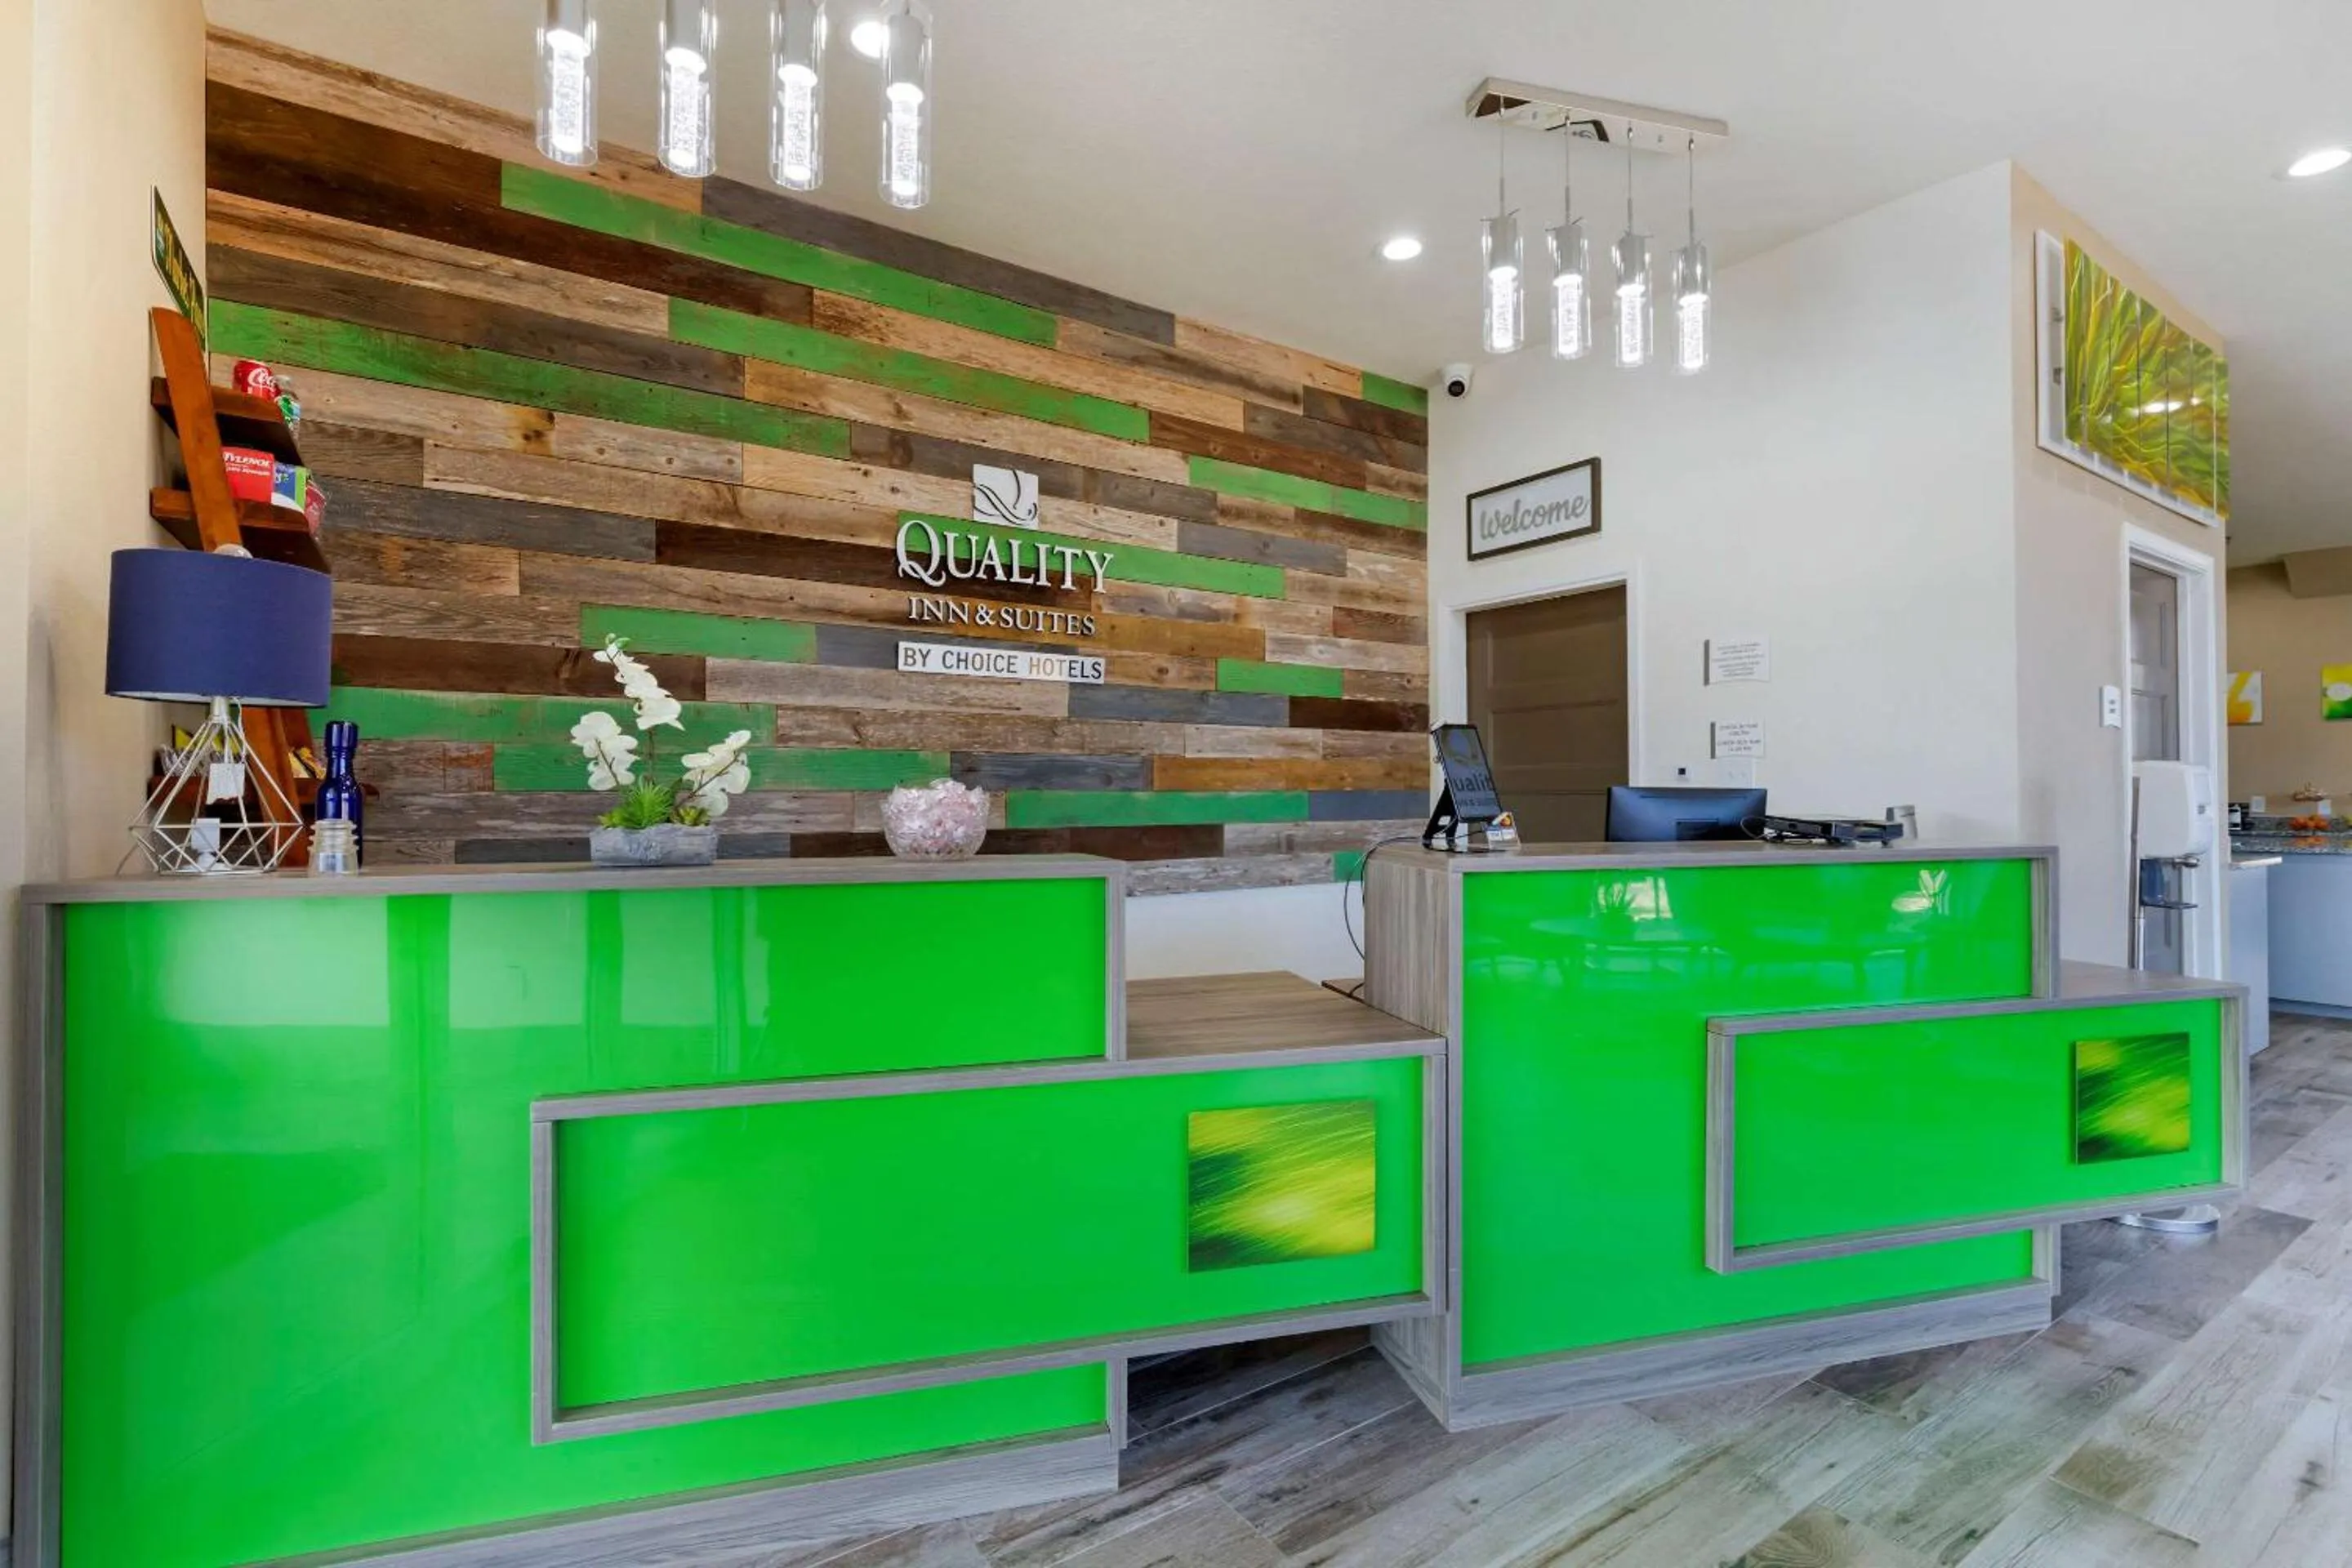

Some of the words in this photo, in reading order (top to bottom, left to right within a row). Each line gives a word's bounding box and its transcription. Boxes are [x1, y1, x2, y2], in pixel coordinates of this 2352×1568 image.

[897, 520, 1114, 594] QUALITY
[908, 597, 969, 625] INN
[999, 607, 1096, 635] SUITES
[902, 647, 932, 668] BY
[942, 650, 1018, 674] CHOICE
[1029, 657, 1102, 679] HOTELS
